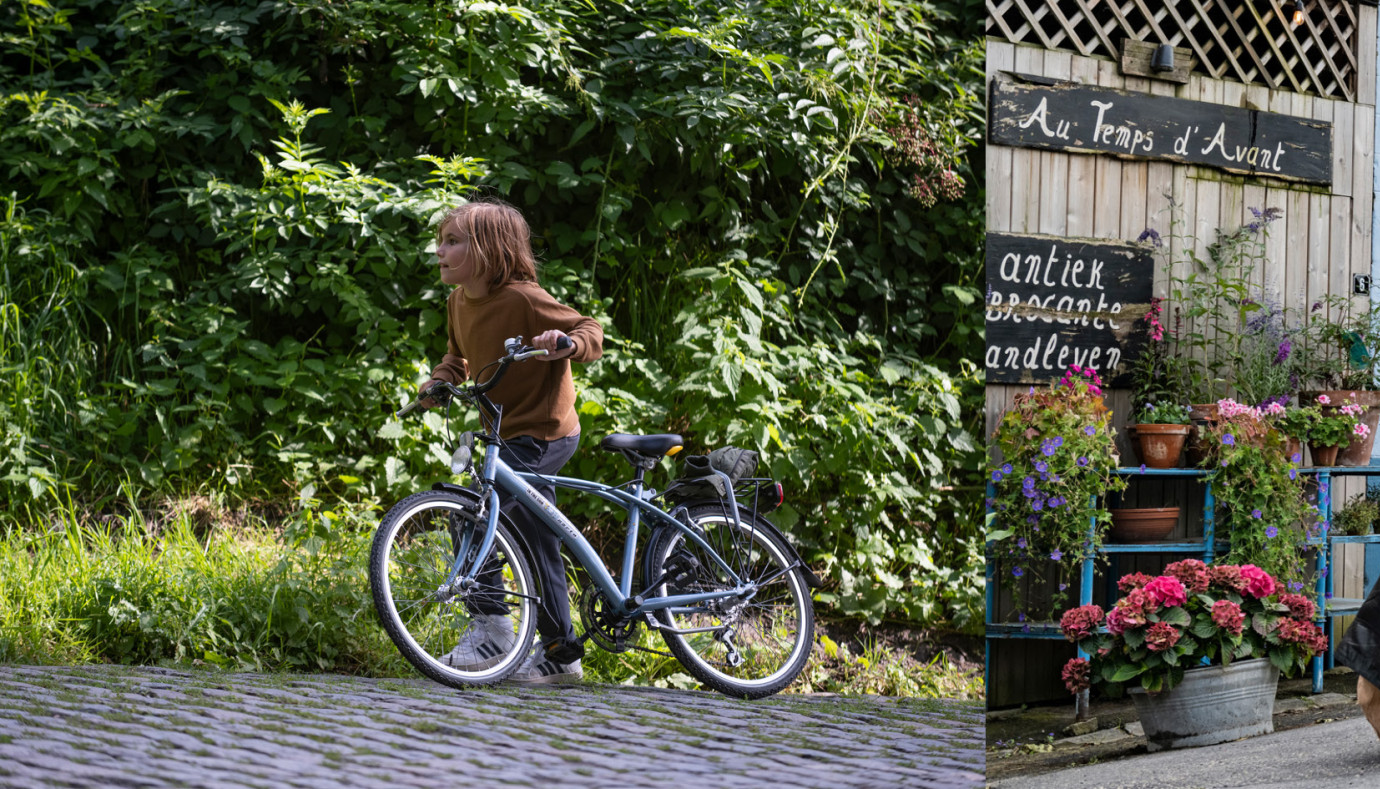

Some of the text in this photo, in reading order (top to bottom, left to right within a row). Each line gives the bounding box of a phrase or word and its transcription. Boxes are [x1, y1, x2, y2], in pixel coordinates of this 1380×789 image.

[1018, 96, 1286, 172] Au Temps d'Avant
[1359, 277, 1365, 291] 6
